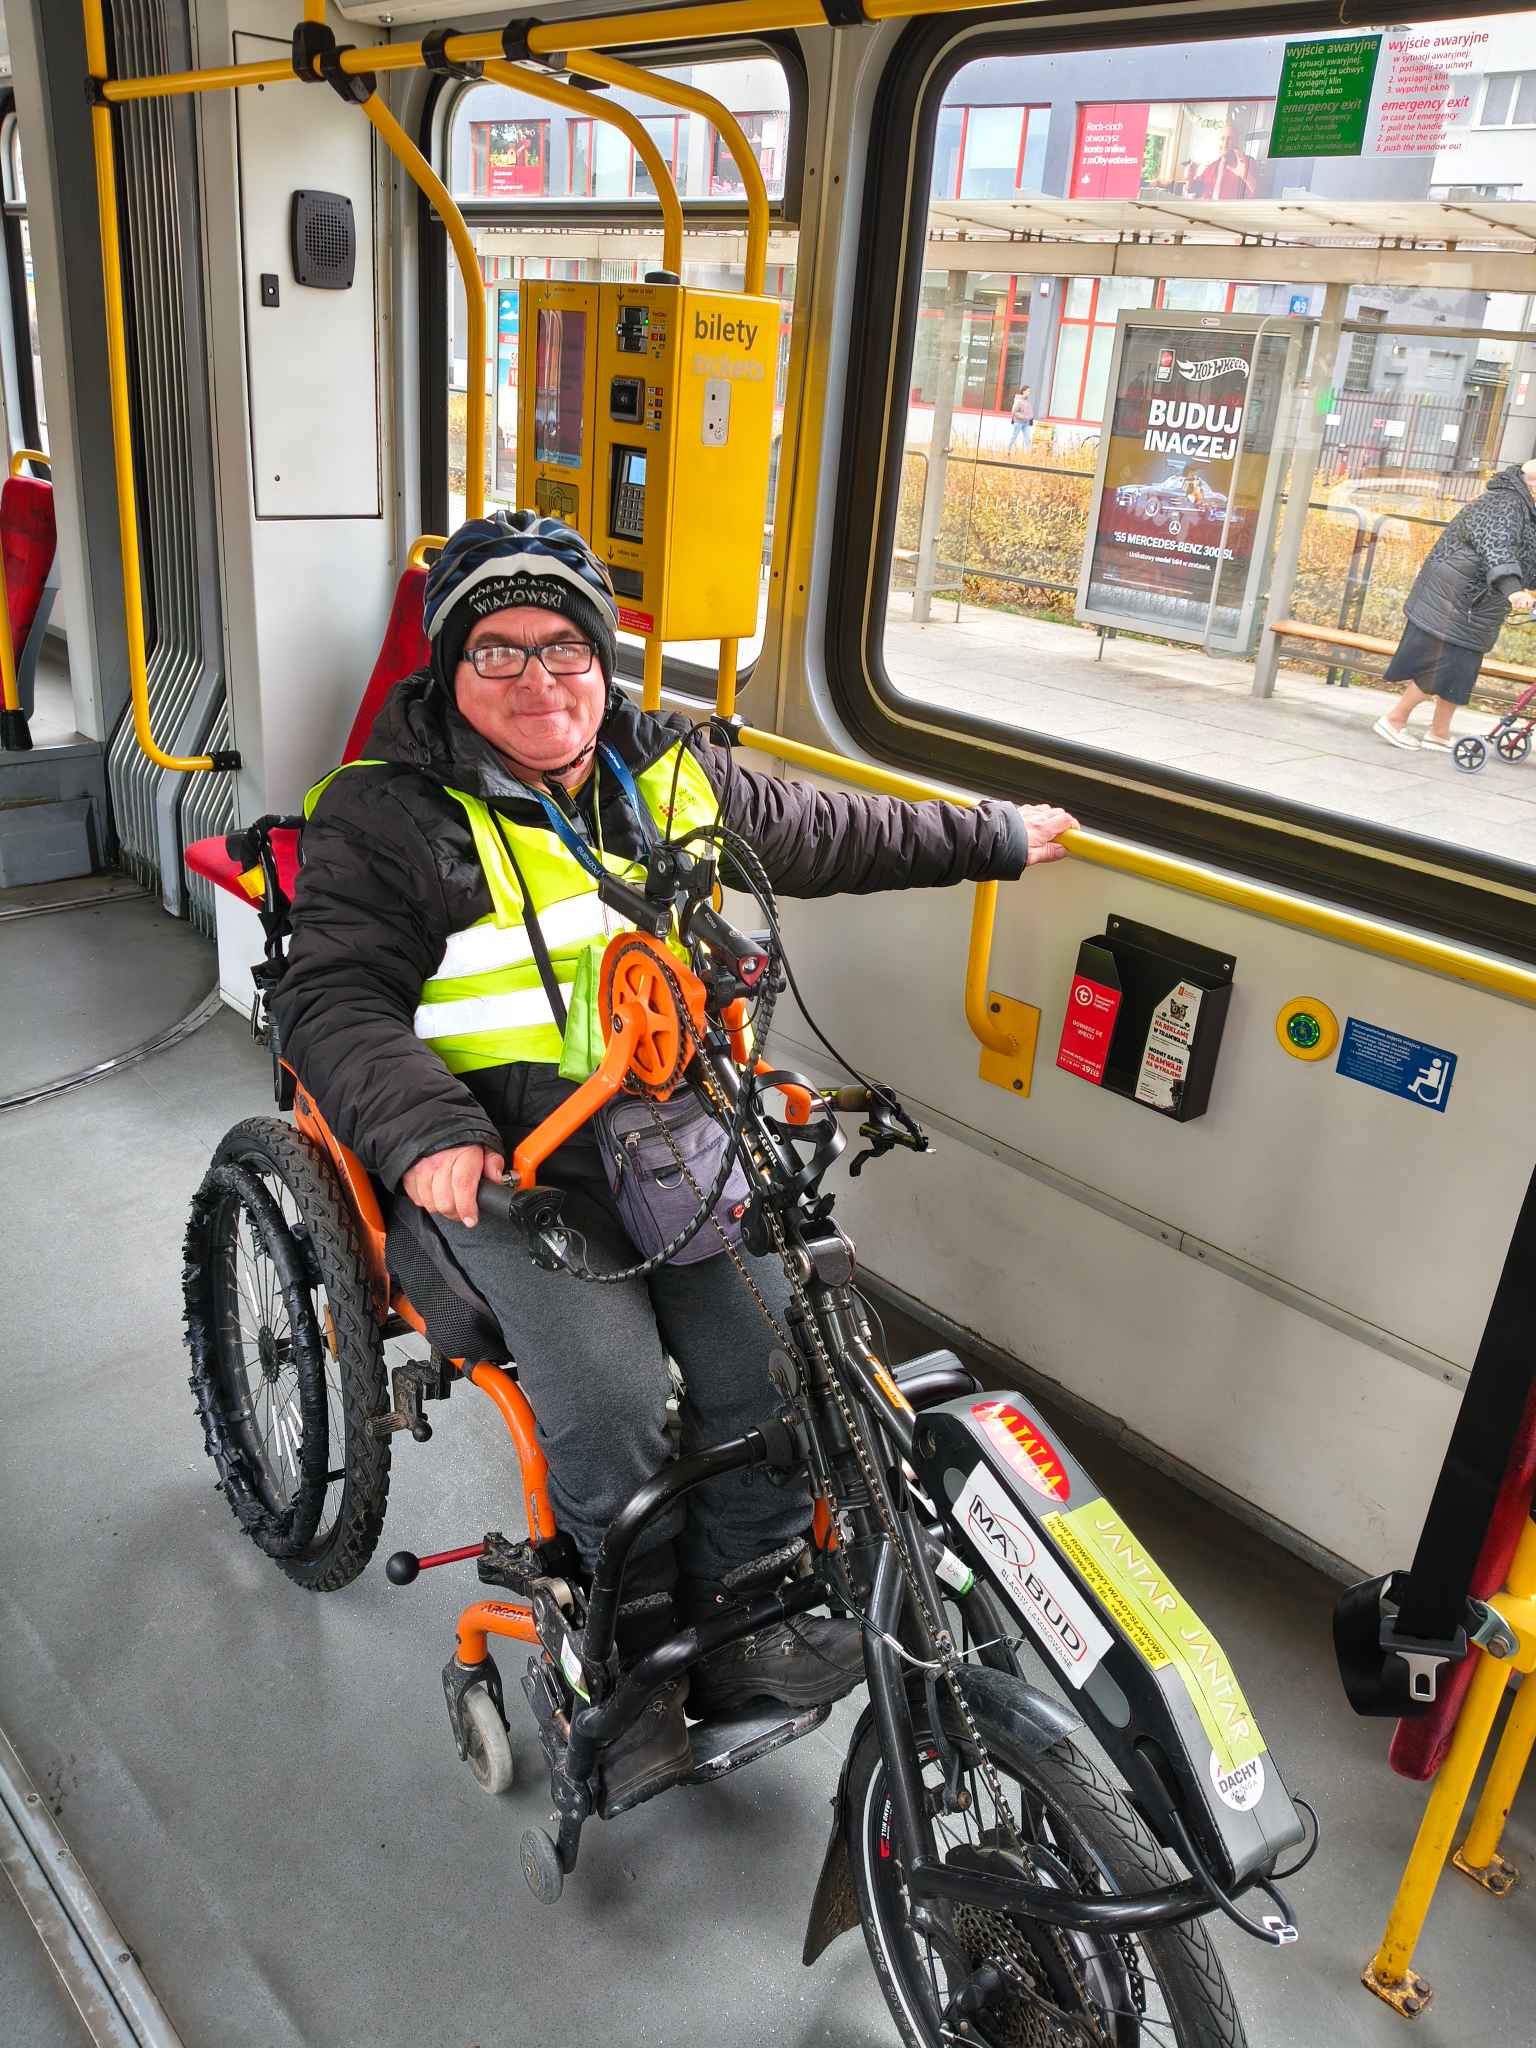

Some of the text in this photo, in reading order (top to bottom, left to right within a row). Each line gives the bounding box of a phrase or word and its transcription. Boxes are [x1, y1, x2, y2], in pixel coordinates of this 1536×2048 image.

[1286, 39, 1377, 59] wyjście awaryjne
[1388, 32, 1489, 52] wyjście awaryjne
[1283, 102, 1339, 115] emergency
[1381, 95, 1469, 112] emergency exit
[1417, 123, 1442, 131] handle
[1403, 143, 1416, 151] the
[1417, 143, 1447, 151] window
[694, 312, 758, 350] bilety
[1148, 399, 1242, 434] BUDUJ
[1144, 429, 1237, 460] INACZEJ
[1126, 533, 1202, 555] MERCEDES-BENZ
[1222, 549, 1235, 560] SL
[1054, 1516, 1073, 1541] PORT
[1070, 1538, 1109, 1587] ROWEROWY
[1057, 1533, 1087, 1573] PORTOWA
[972, 1500, 1082, 1651] MAXBUD
[1095, 1518, 1250, 1743] JANTAR JANTAR
[1218, 1760, 1258, 1794] DACHY
